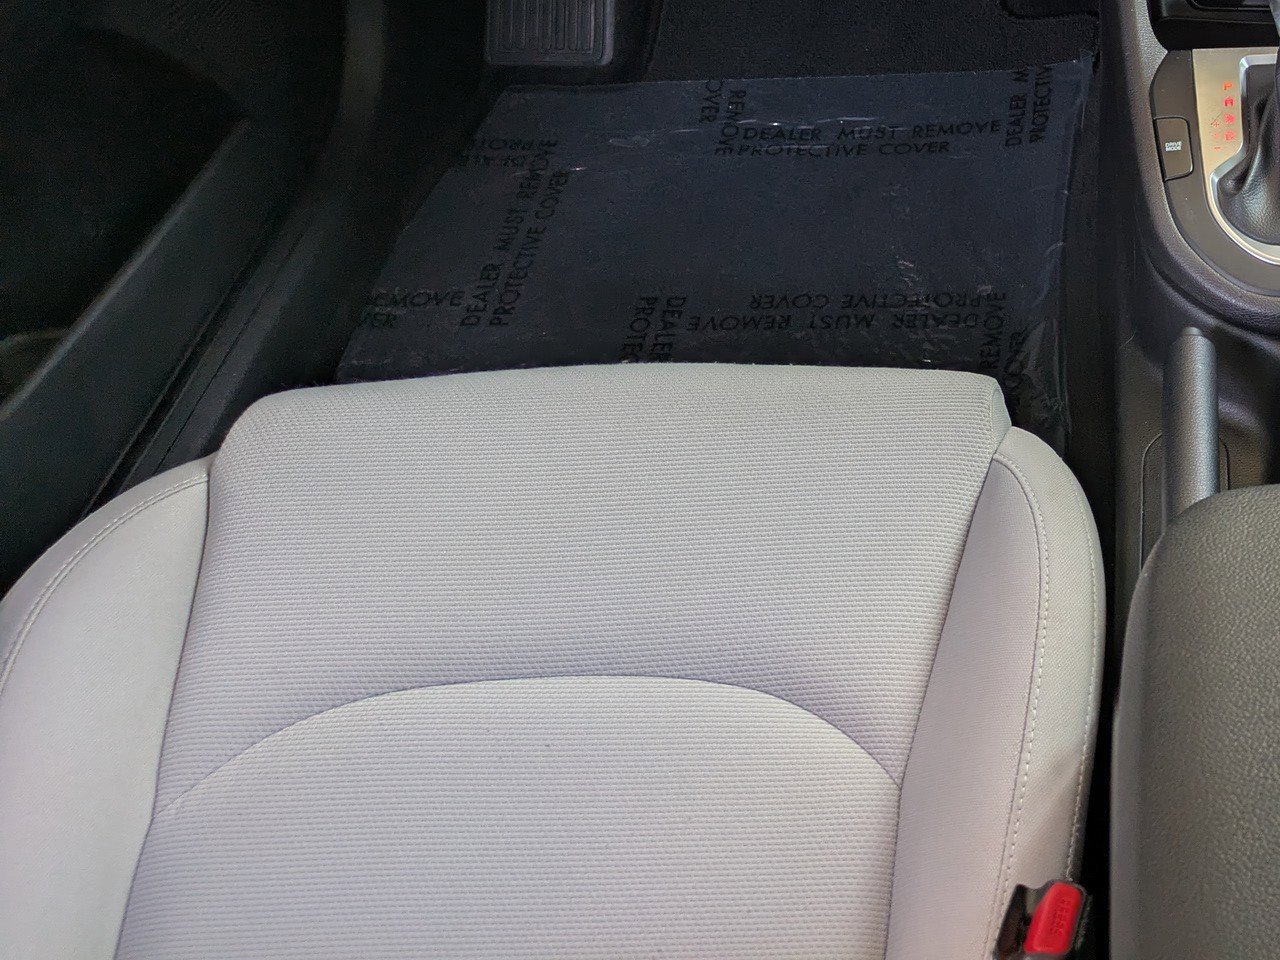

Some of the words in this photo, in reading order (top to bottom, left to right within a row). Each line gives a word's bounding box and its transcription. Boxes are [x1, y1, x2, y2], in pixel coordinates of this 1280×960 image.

[714, 89, 747, 156] REMOVE
[743, 126, 823, 142] DEALER
[836, 125, 898, 140] MUST
[912, 119, 1003, 140] REMOVE
[1004, 93, 1029, 148] DEALER
[878, 141, 950, 156] COVER
[488, 227, 546, 327] PROTECTIVE
[460, 262, 504, 328] DEALER
[749, 292, 830, 310] COVER
[686, 312, 791, 333] REMOVE
[808, 312, 875, 330] MUST
[893, 312, 978, 330] DEALER
